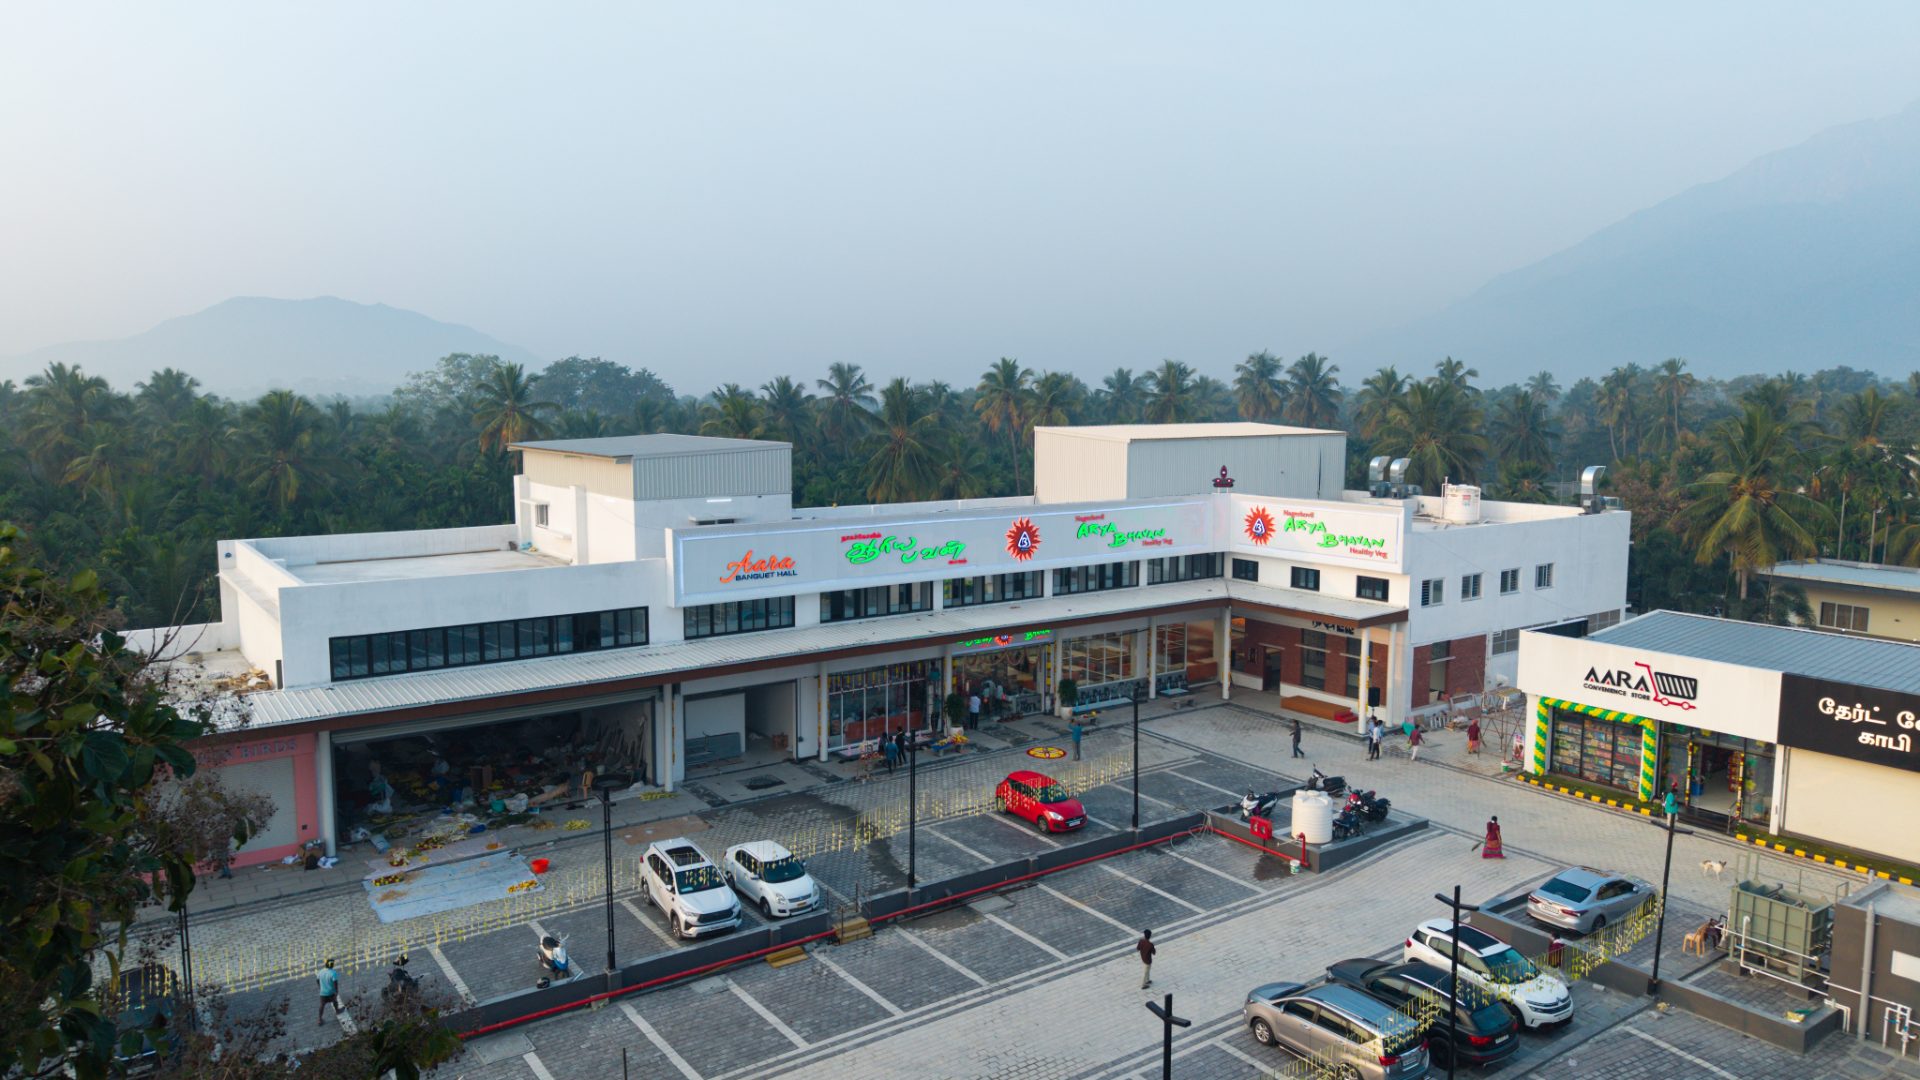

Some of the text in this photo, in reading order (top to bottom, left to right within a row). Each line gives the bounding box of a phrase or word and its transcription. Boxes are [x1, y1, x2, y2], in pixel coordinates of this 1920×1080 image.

[1076, 521, 1118, 540] ARYA
[1283, 516, 1327, 535] ARYA
[1107, 527, 1167, 548] BHAVAN
[1316, 532, 1386, 549] BHAVAN
[1349, 547, 1389, 560] Healthy Veg
[719, 548, 797, 584] Aara
[776, 569, 799, 577] HALL
[1584, 665, 1651, 693] AARA
[1583, 682, 1651, 701] CONVENIENCE STORE
[1818, 697, 1887, 725] தேர்ட்
[1857, 731, 1912, 753] காபி
